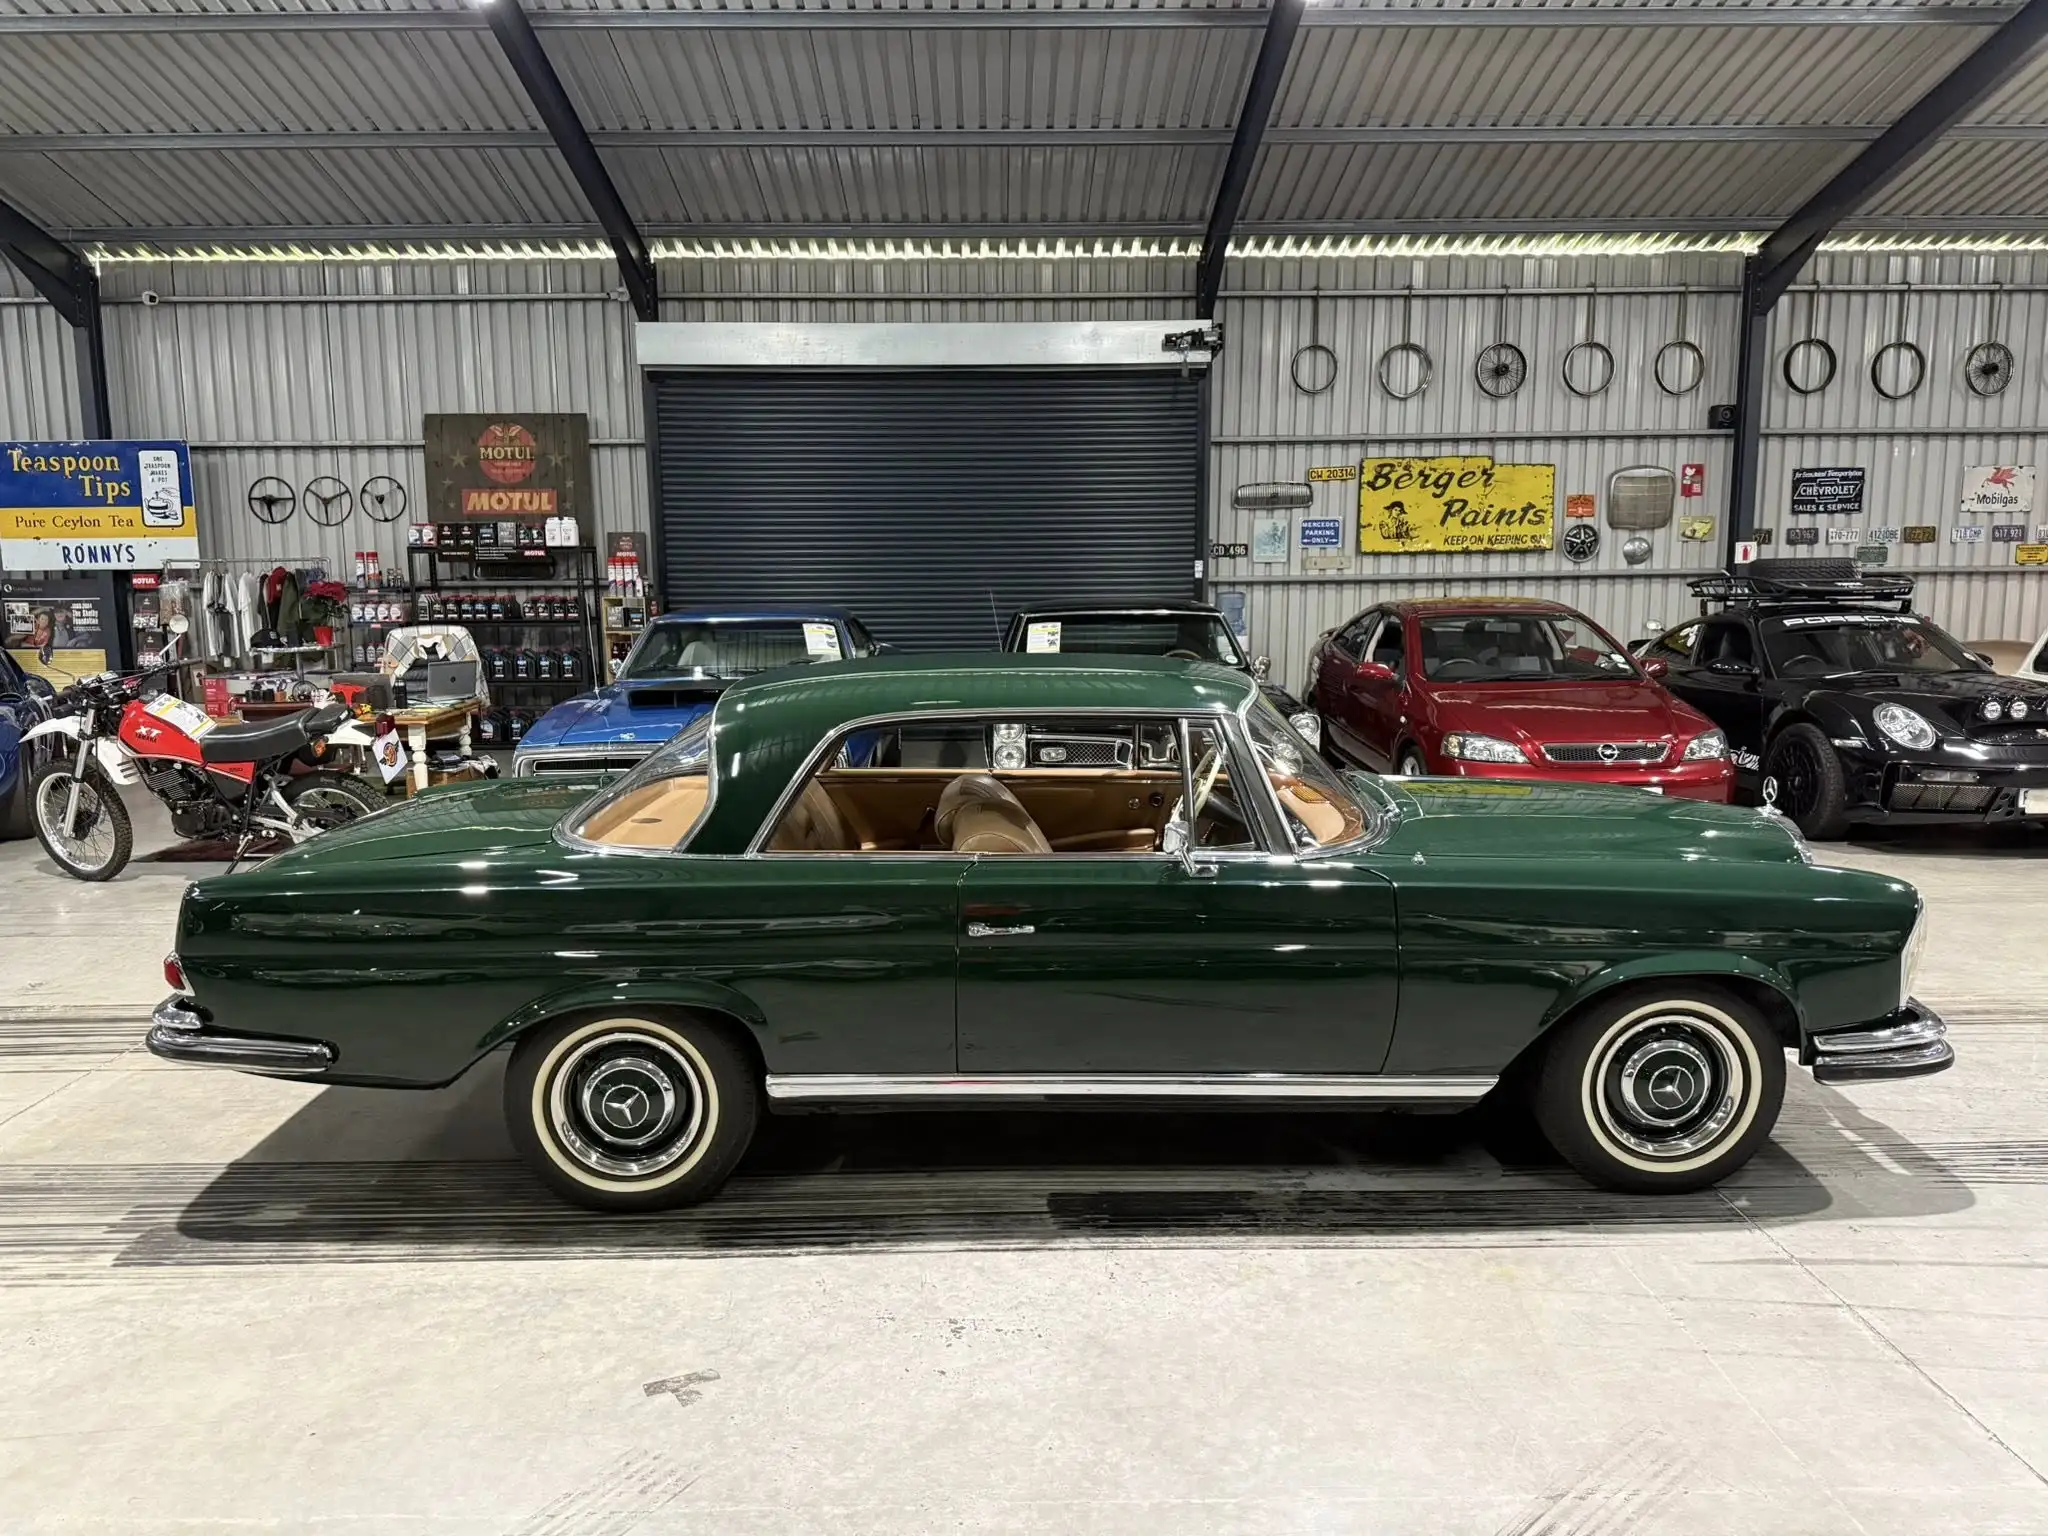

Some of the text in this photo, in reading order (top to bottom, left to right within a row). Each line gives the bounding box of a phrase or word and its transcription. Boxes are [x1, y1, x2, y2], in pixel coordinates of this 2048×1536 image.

[480, 446, 534, 460] MOTUL
[7, 448, 120, 478] Teaspoon
[1326, 467, 1355, 480] 20314
[1365, 461, 1496, 499] Berger
[78, 474, 131, 504] Tips
[1800, 485, 1855, 496] CHEVROLET
[467, 492, 553, 512] MOTUL
[1793, 504, 1817, 512] SALES
[1826, 503, 1860, 512] SERVICE
[1977, 494, 2018, 508] Mobilgas
[1438, 498, 1548, 530] Paints
[15, 515, 134, 531] Pure Ceylon Tea
[1443, 535, 1468, 546] KEEP
[1469, 535, 1485, 545] ON
[1487, 533, 1529, 545] KEEPING
[62, 545, 135, 564] RONNYS
[1229, 545, 1246, 555] 496
[1783, 615, 1921, 627] PORSCHE
[135, 725, 162, 737] XT
